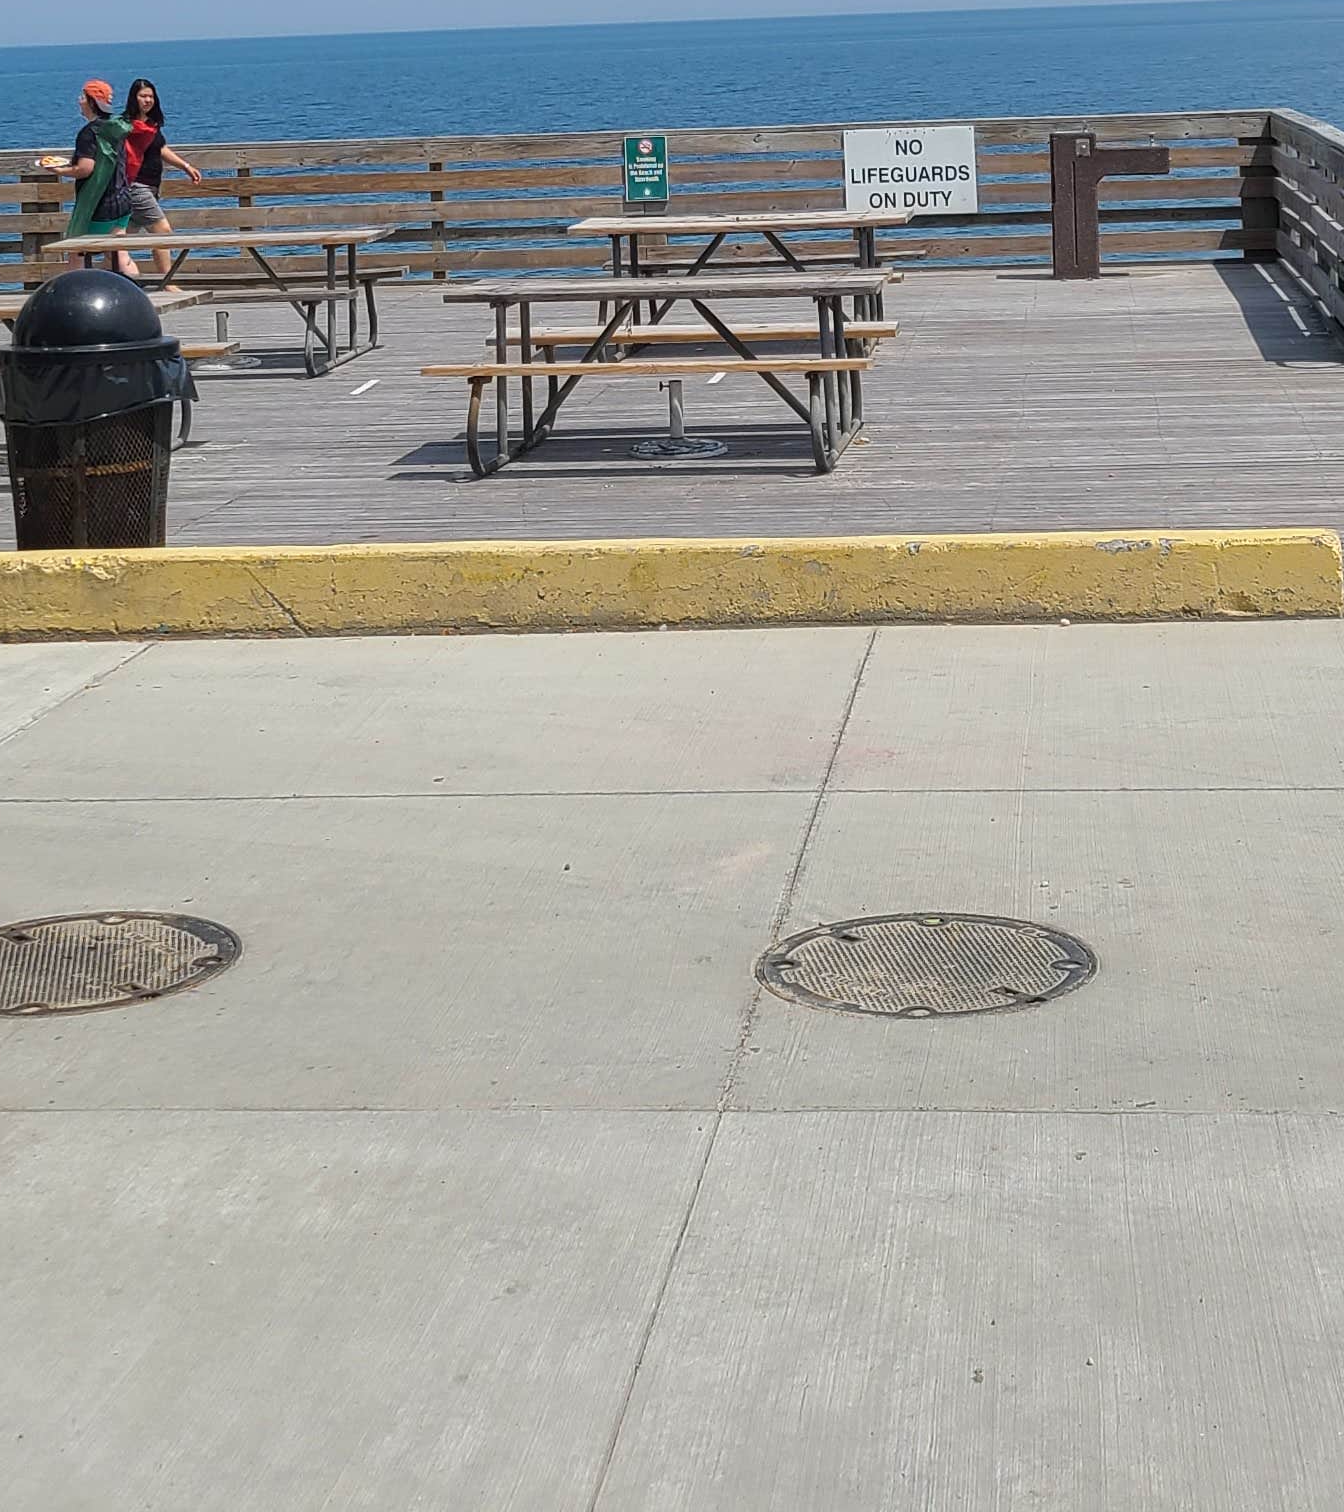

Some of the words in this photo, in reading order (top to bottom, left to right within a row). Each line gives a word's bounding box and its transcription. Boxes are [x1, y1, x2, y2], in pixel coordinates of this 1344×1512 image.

[895, 139, 923, 156] NO
[850, 165, 970, 184] LIFEGUARDS
[869, 192, 897, 208] ON
[904, 191, 952, 207] DUTY
